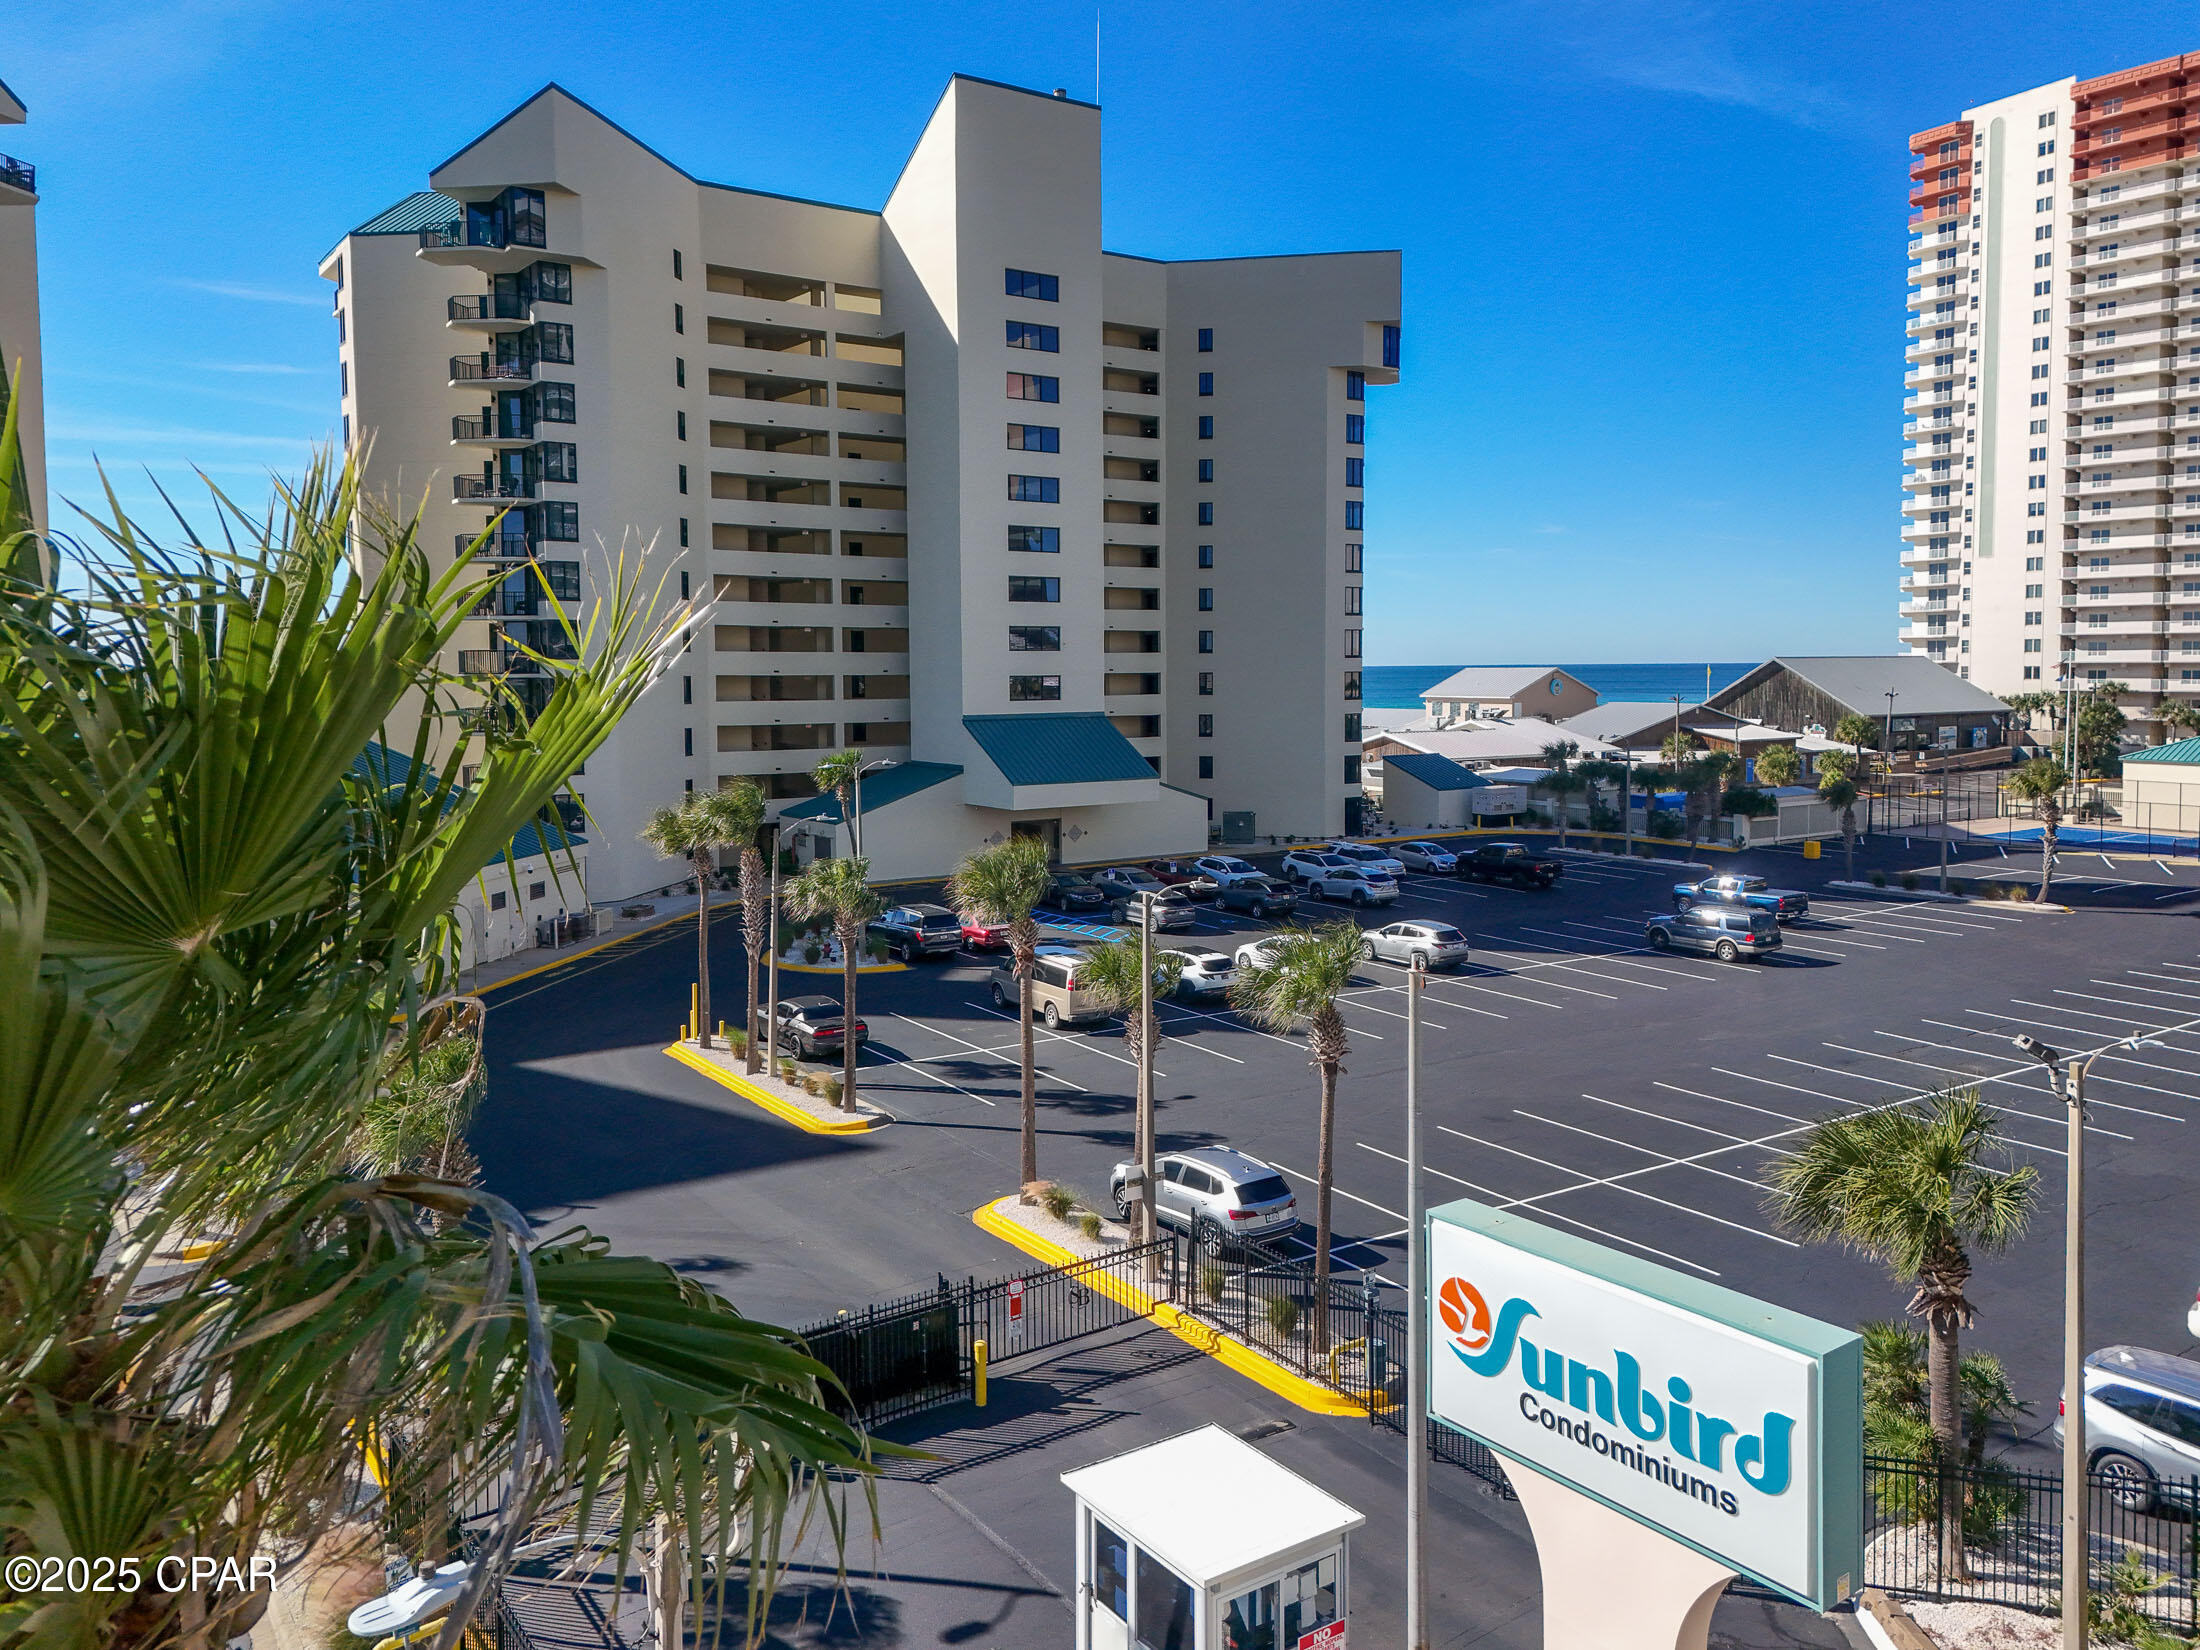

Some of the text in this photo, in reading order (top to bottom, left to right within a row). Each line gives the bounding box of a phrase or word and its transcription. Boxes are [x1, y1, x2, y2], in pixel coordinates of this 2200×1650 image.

[1446, 1297, 1797, 1496] Sunbird
[1518, 1391, 1739, 1517] Condominiums
[1313, 1627, 1332, 1645] NO
